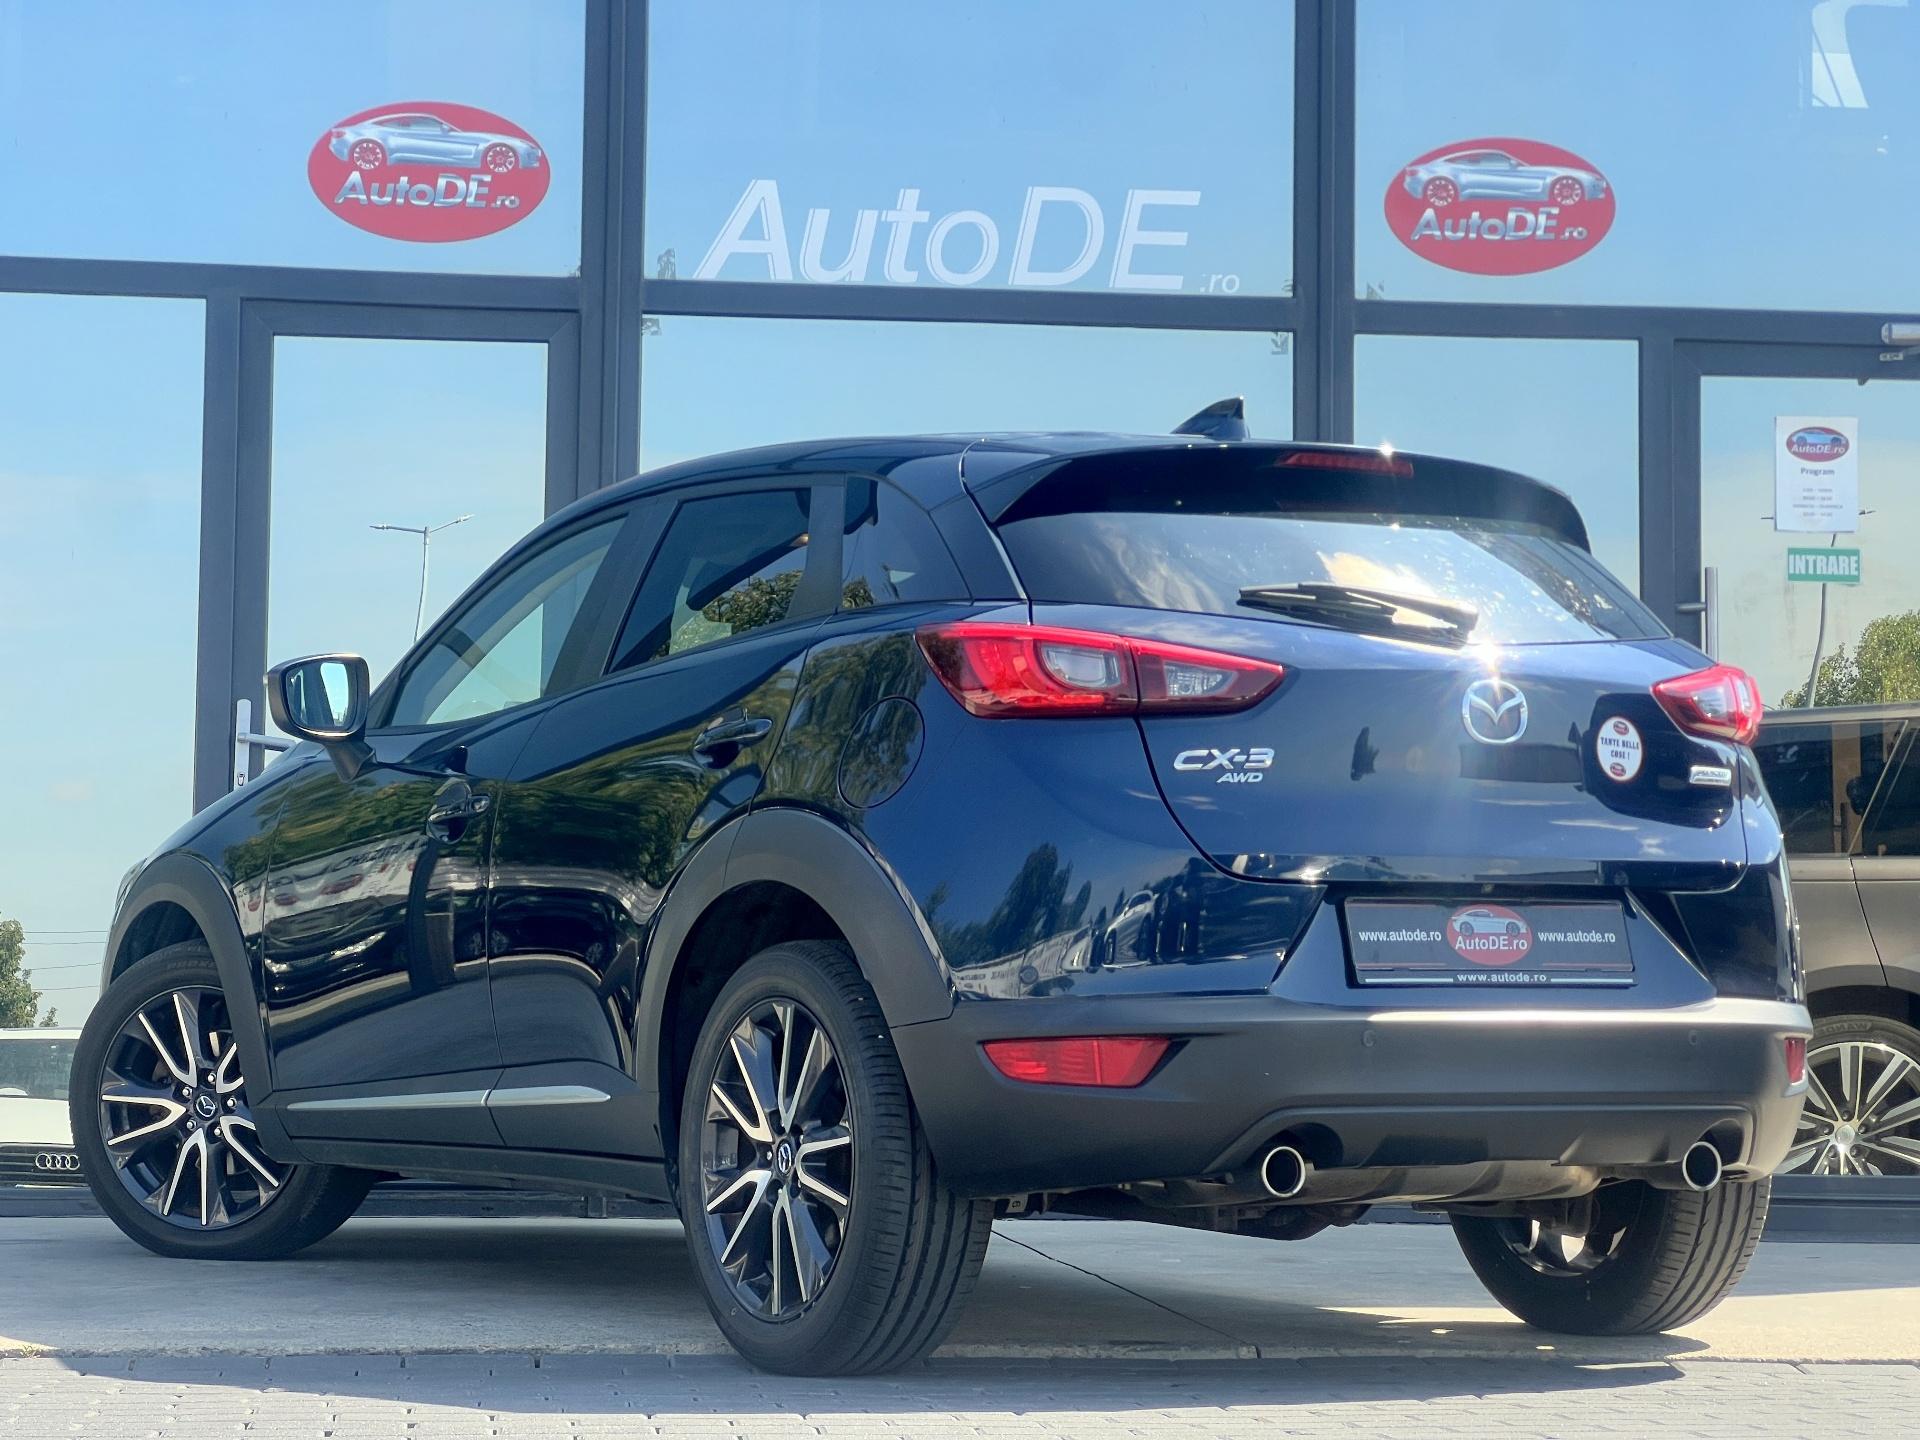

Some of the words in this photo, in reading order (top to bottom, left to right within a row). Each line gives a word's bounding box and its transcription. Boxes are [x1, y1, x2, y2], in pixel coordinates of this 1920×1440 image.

[1791, 443, 1846, 454] AutoDE.ro
[1800, 467, 1835, 476] Program
[1788, 554, 1859, 576] INTRARE
[1173, 748, 1275, 771] CX-3
[1216, 772, 1264, 783] AWD
[1358, 928, 1442, 942] www.autode.ro
[1537, 930, 1616, 943] www.autode.ro
[1455, 935, 1528, 950] AutoDE.ro
[1456, 972, 1547, 983] www.autode.ro
